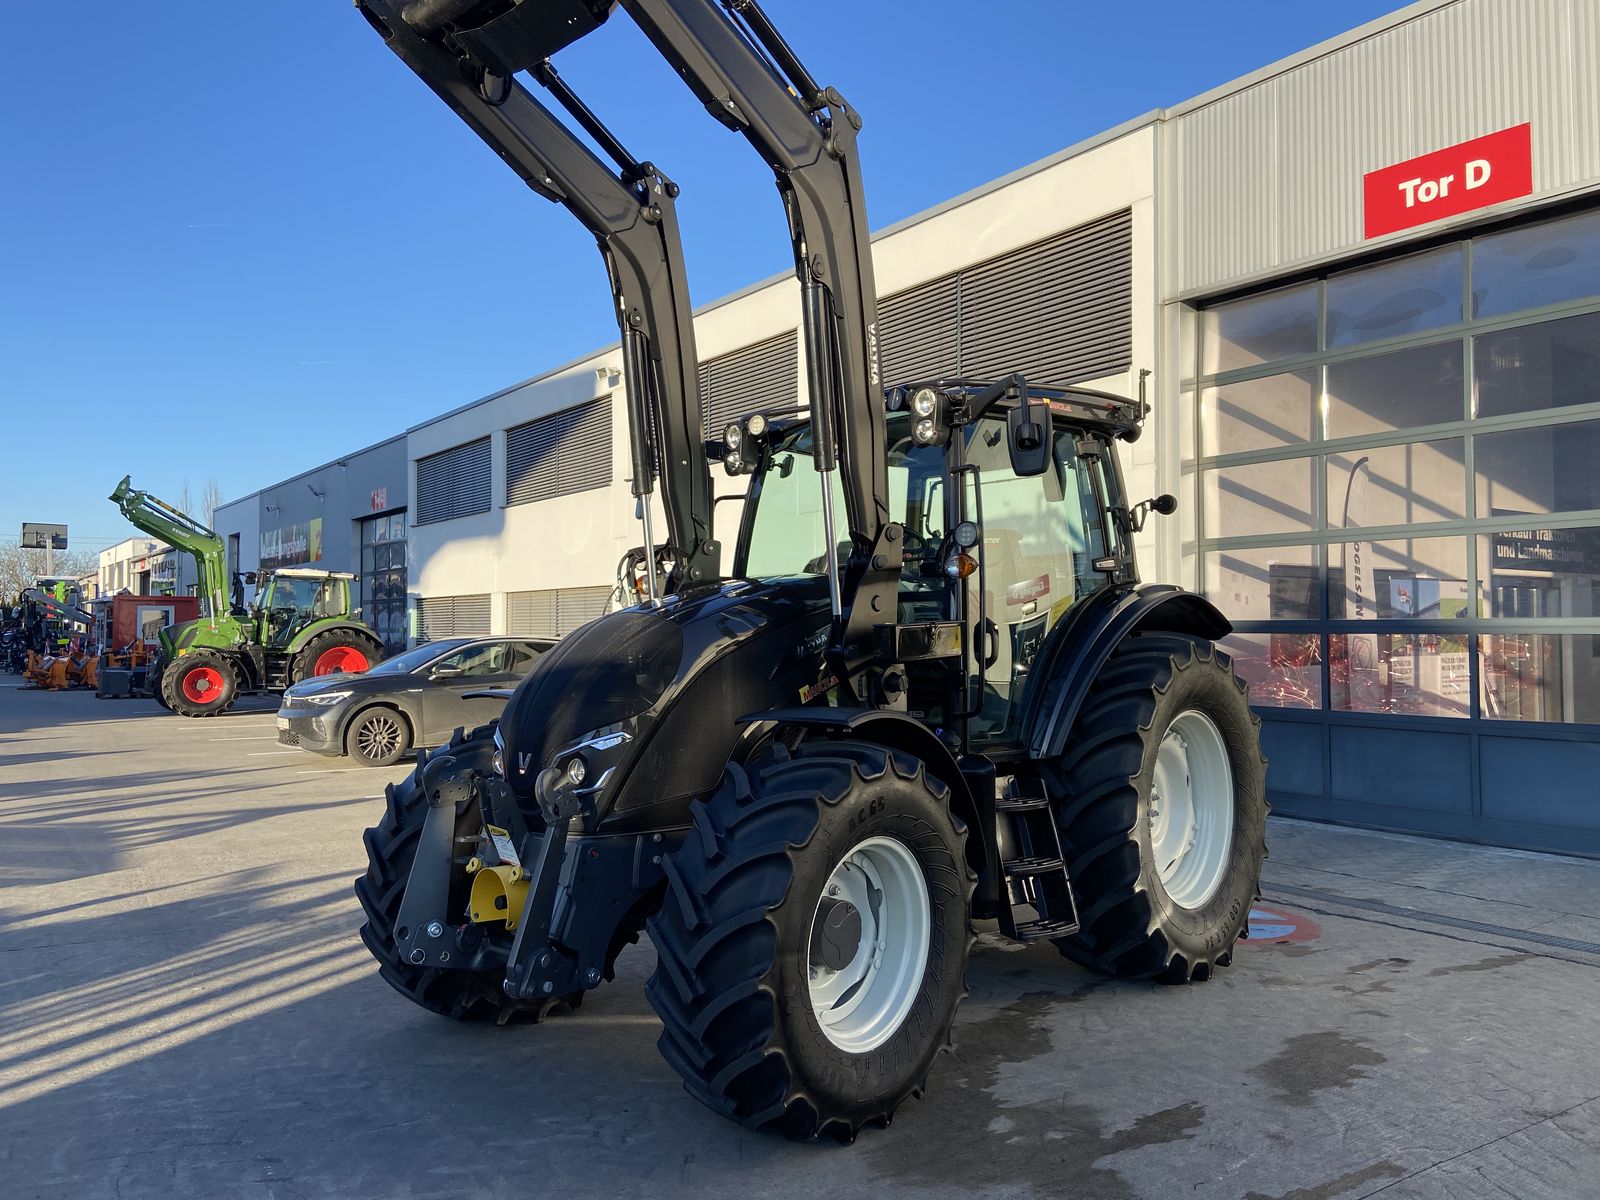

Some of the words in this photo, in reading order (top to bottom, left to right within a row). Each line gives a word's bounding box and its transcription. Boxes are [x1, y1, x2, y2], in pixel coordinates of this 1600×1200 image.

[1398, 174, 1454, 208] Tor
[1466, 159, 1491, 191] D
[867, 322, 879, 386] VALTRA
[1497, 543, 1516, 558] und
[1518, 542, 1585, 563] Landmaschinen
[1353, 541, 1364, 619] OGELSAN
[869, 795, 886, 816] 65
